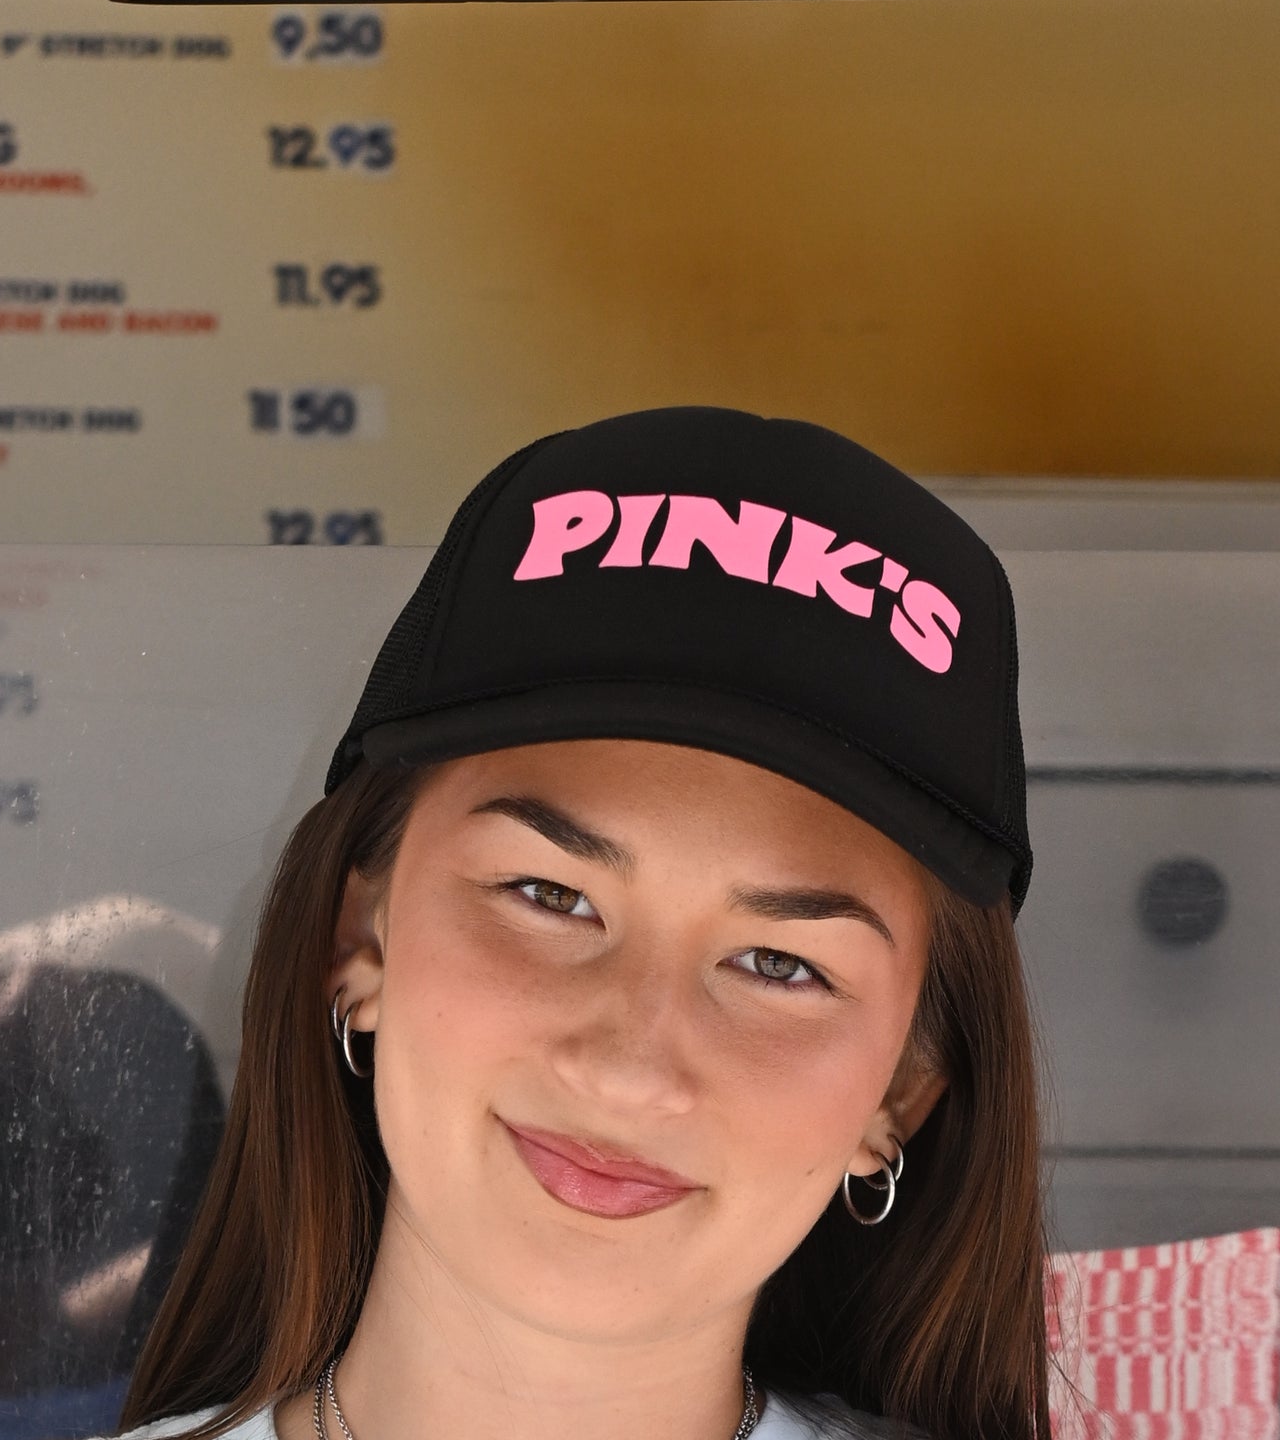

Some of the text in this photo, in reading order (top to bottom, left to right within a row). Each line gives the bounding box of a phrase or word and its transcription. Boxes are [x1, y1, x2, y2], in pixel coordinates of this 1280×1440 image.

[273, 14, 385, 58] 9.50
[268, 126, 397, 170] 12.95
[274, 264, 381, 309] 11.95
[265, 510, 384, 545] 1295
[513, 490, 961, 674] PINK'S
